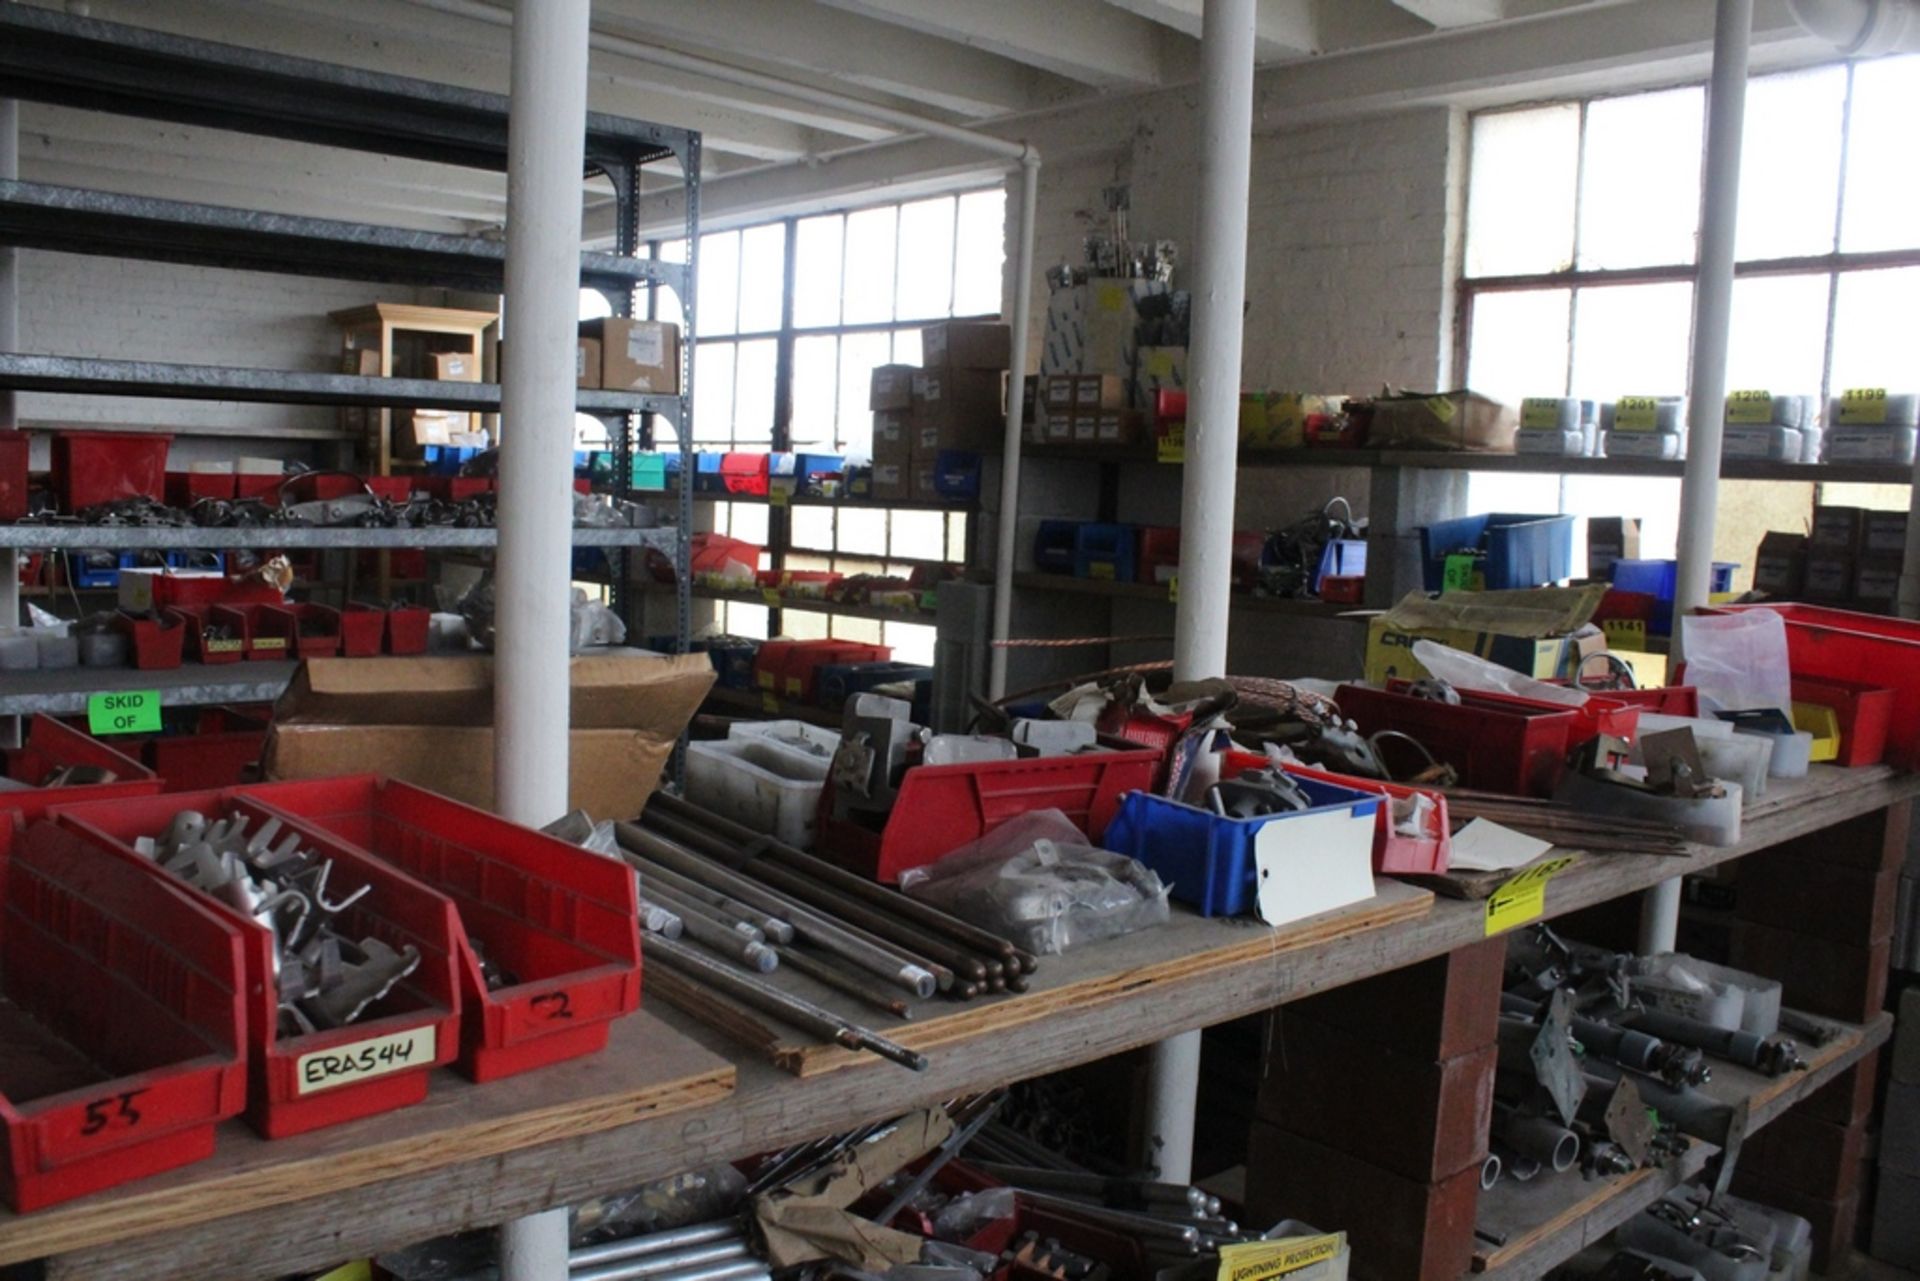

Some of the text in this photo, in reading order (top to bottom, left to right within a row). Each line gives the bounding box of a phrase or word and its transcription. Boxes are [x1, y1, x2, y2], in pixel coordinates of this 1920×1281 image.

[1734, 390, 1771, 401] 1200
[1845, 388, 1886, 400] 1199
[1621, 399, 1655, 410] 1201
[1608, 621, 1642, 632] 1141
[104, 694, 144, 710] SKID
[113, 715, 136, 729] OF
[305, 1038, 414, 1084] ERA544
[1232, 1242, 1335, 1281] LIGHTNING PROTECTION
